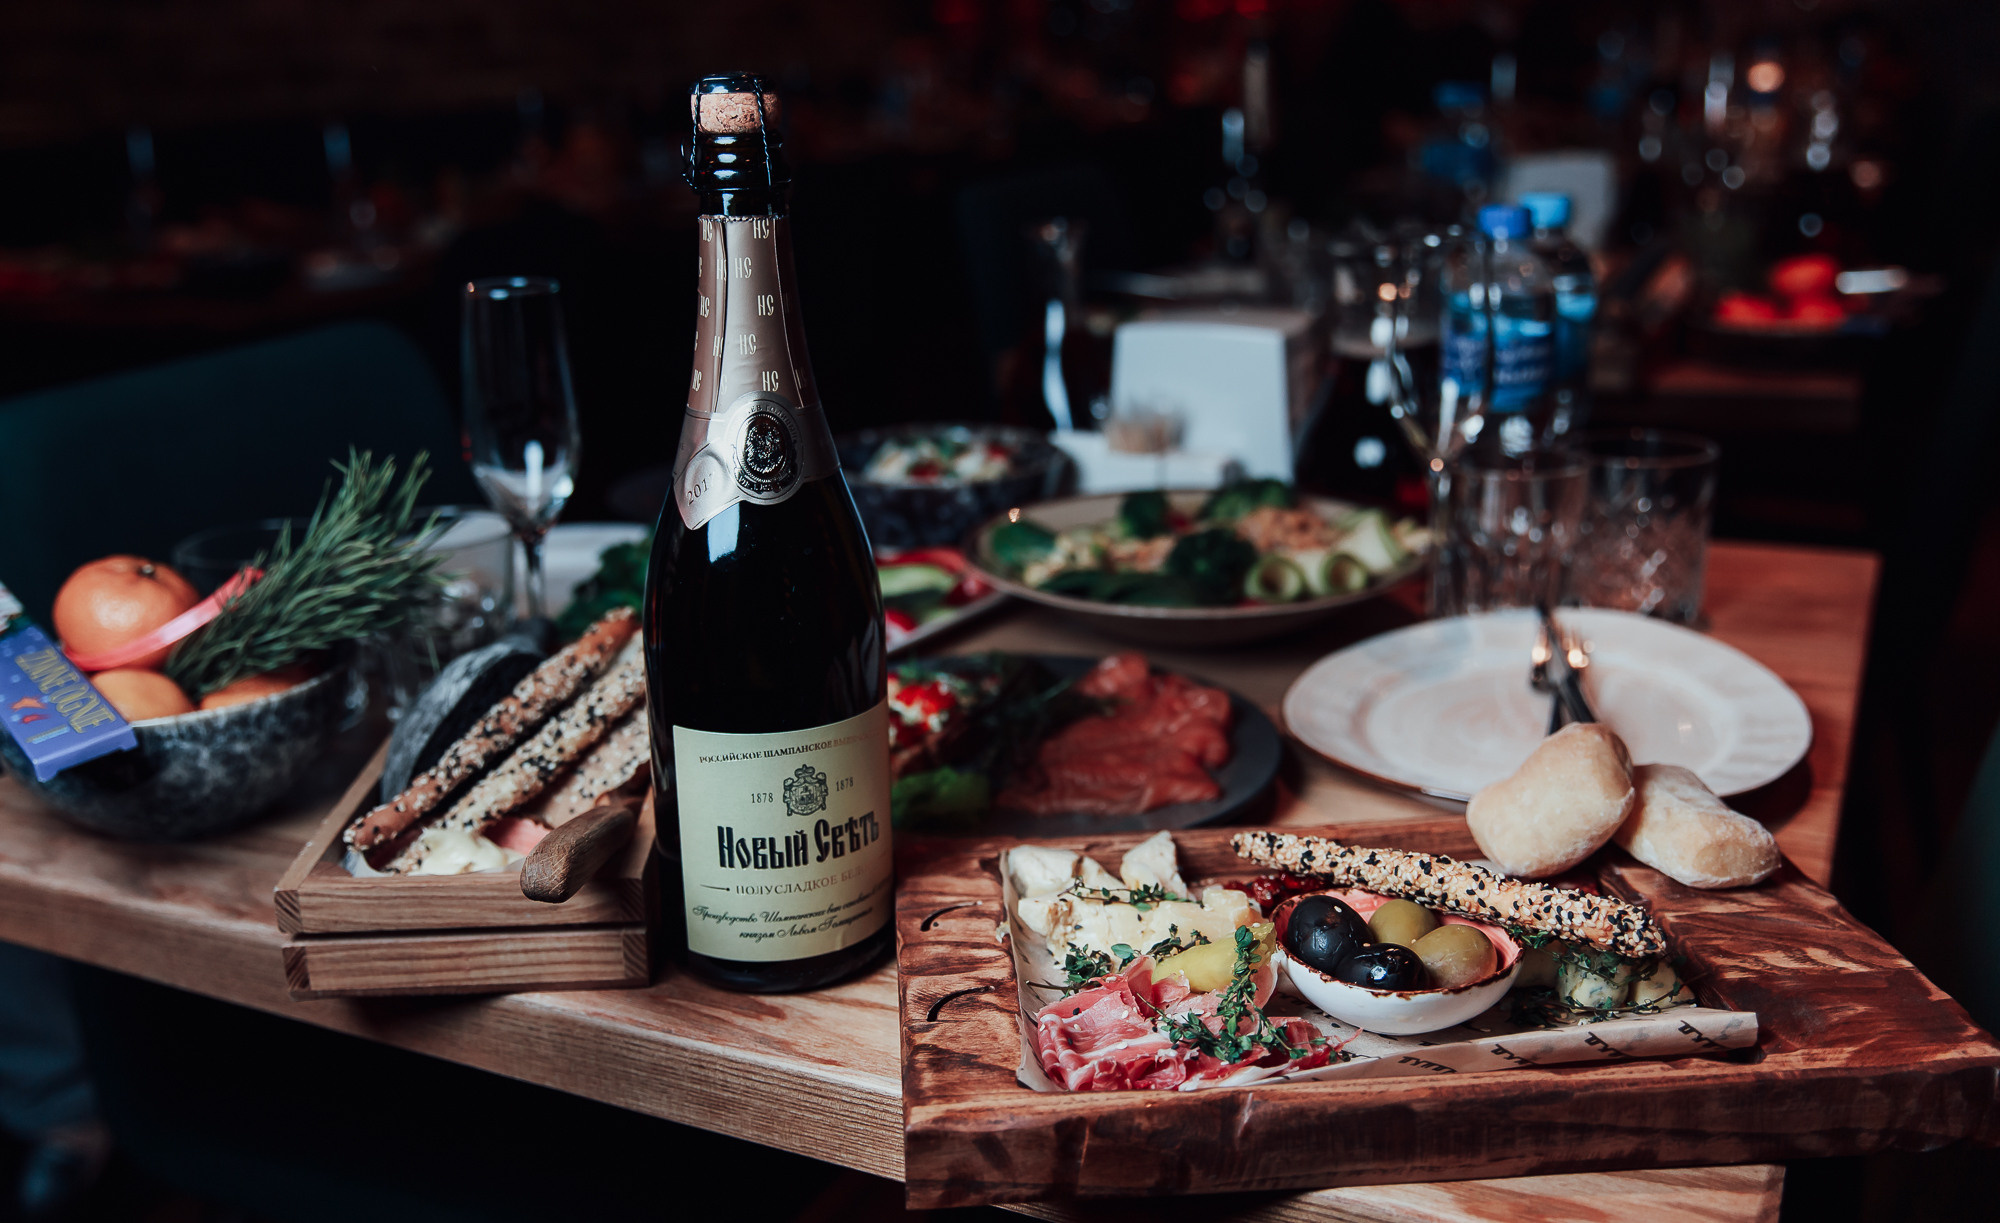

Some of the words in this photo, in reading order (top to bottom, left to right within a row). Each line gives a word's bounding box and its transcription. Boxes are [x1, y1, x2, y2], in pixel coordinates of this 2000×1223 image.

[686, 474, 713, 506] 201
[699, 750, 763, 764] РОССИЙСКОЕ
[763, 740, 833, 759] ШАМПАНСКОЕ
[836, 776, 853, 792] 1878
[751, 792, 774, 804] 1878
[736, 875, 838, 896] ПОЛУСЛАДКОЕ
